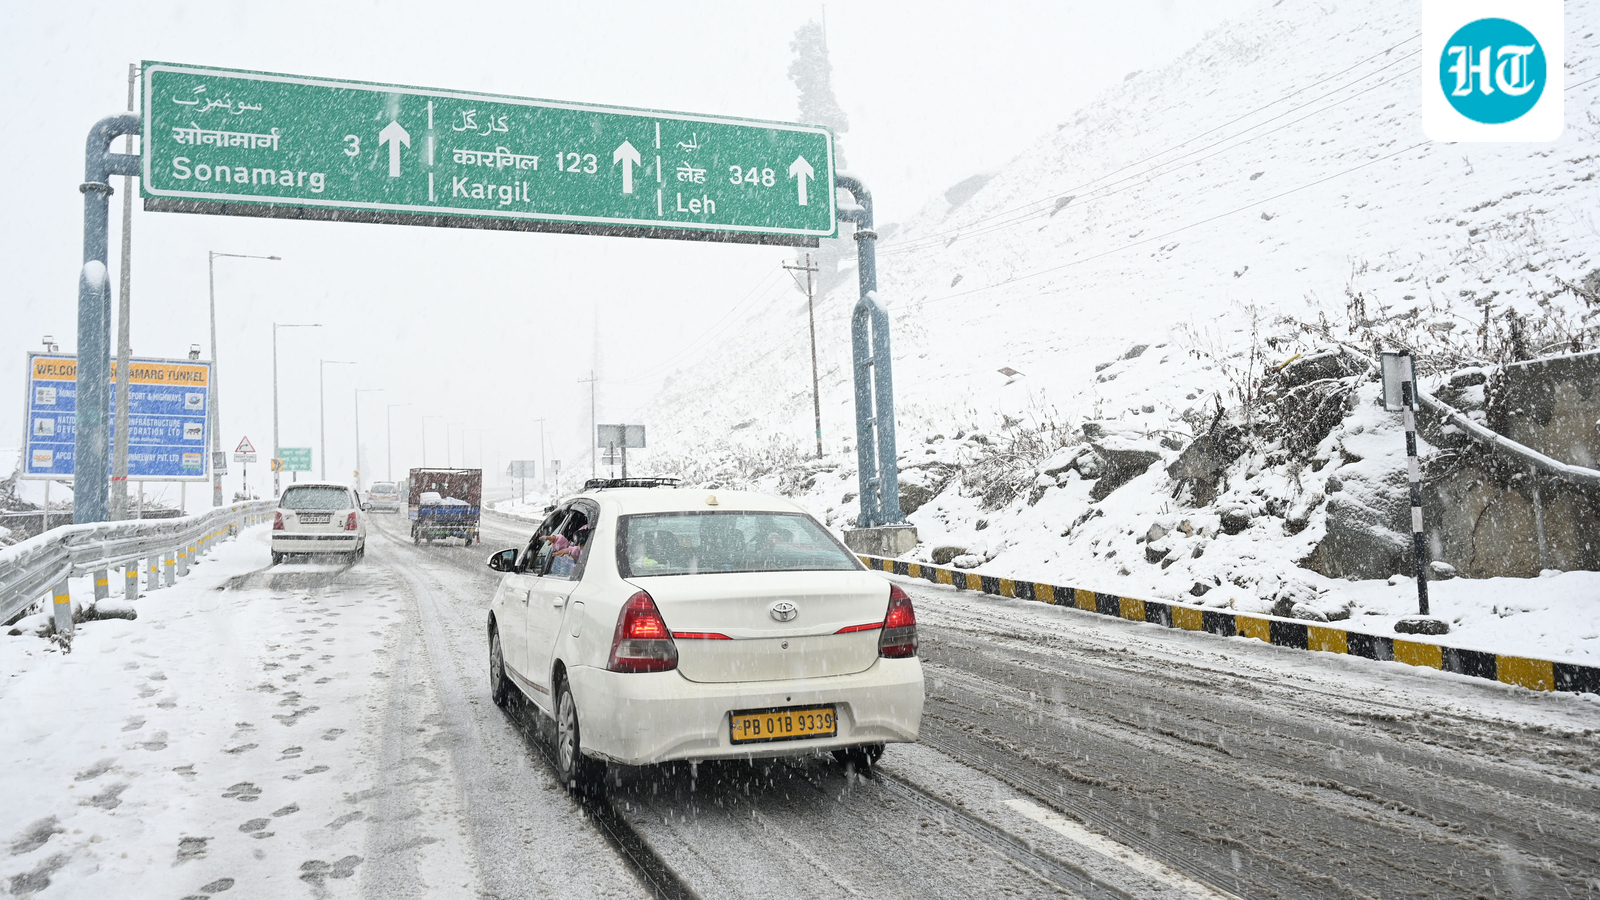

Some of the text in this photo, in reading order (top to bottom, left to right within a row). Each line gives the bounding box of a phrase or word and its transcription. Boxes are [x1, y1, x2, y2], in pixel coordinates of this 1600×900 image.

[172, 121, 361, 157] सोनामार्ग 3
[452, 146, 598, 174] कारगिल 123
[172, 156, 325, 193] Sonamarg
[676, 162, 776, 187] लेह 348
[452, 176, 531, 205] Kargil
[676, 192, 716, 214] Leh
[37, 364, 204, 382] WELCO SAMARG TUNNEL
[153, 393, 182, 401] HIGHWAYS
[55, 451, 71, 460] APCO
[169, 454, 180, 462] LTD
[743, 713, 833, 736] PB 01B 9339
